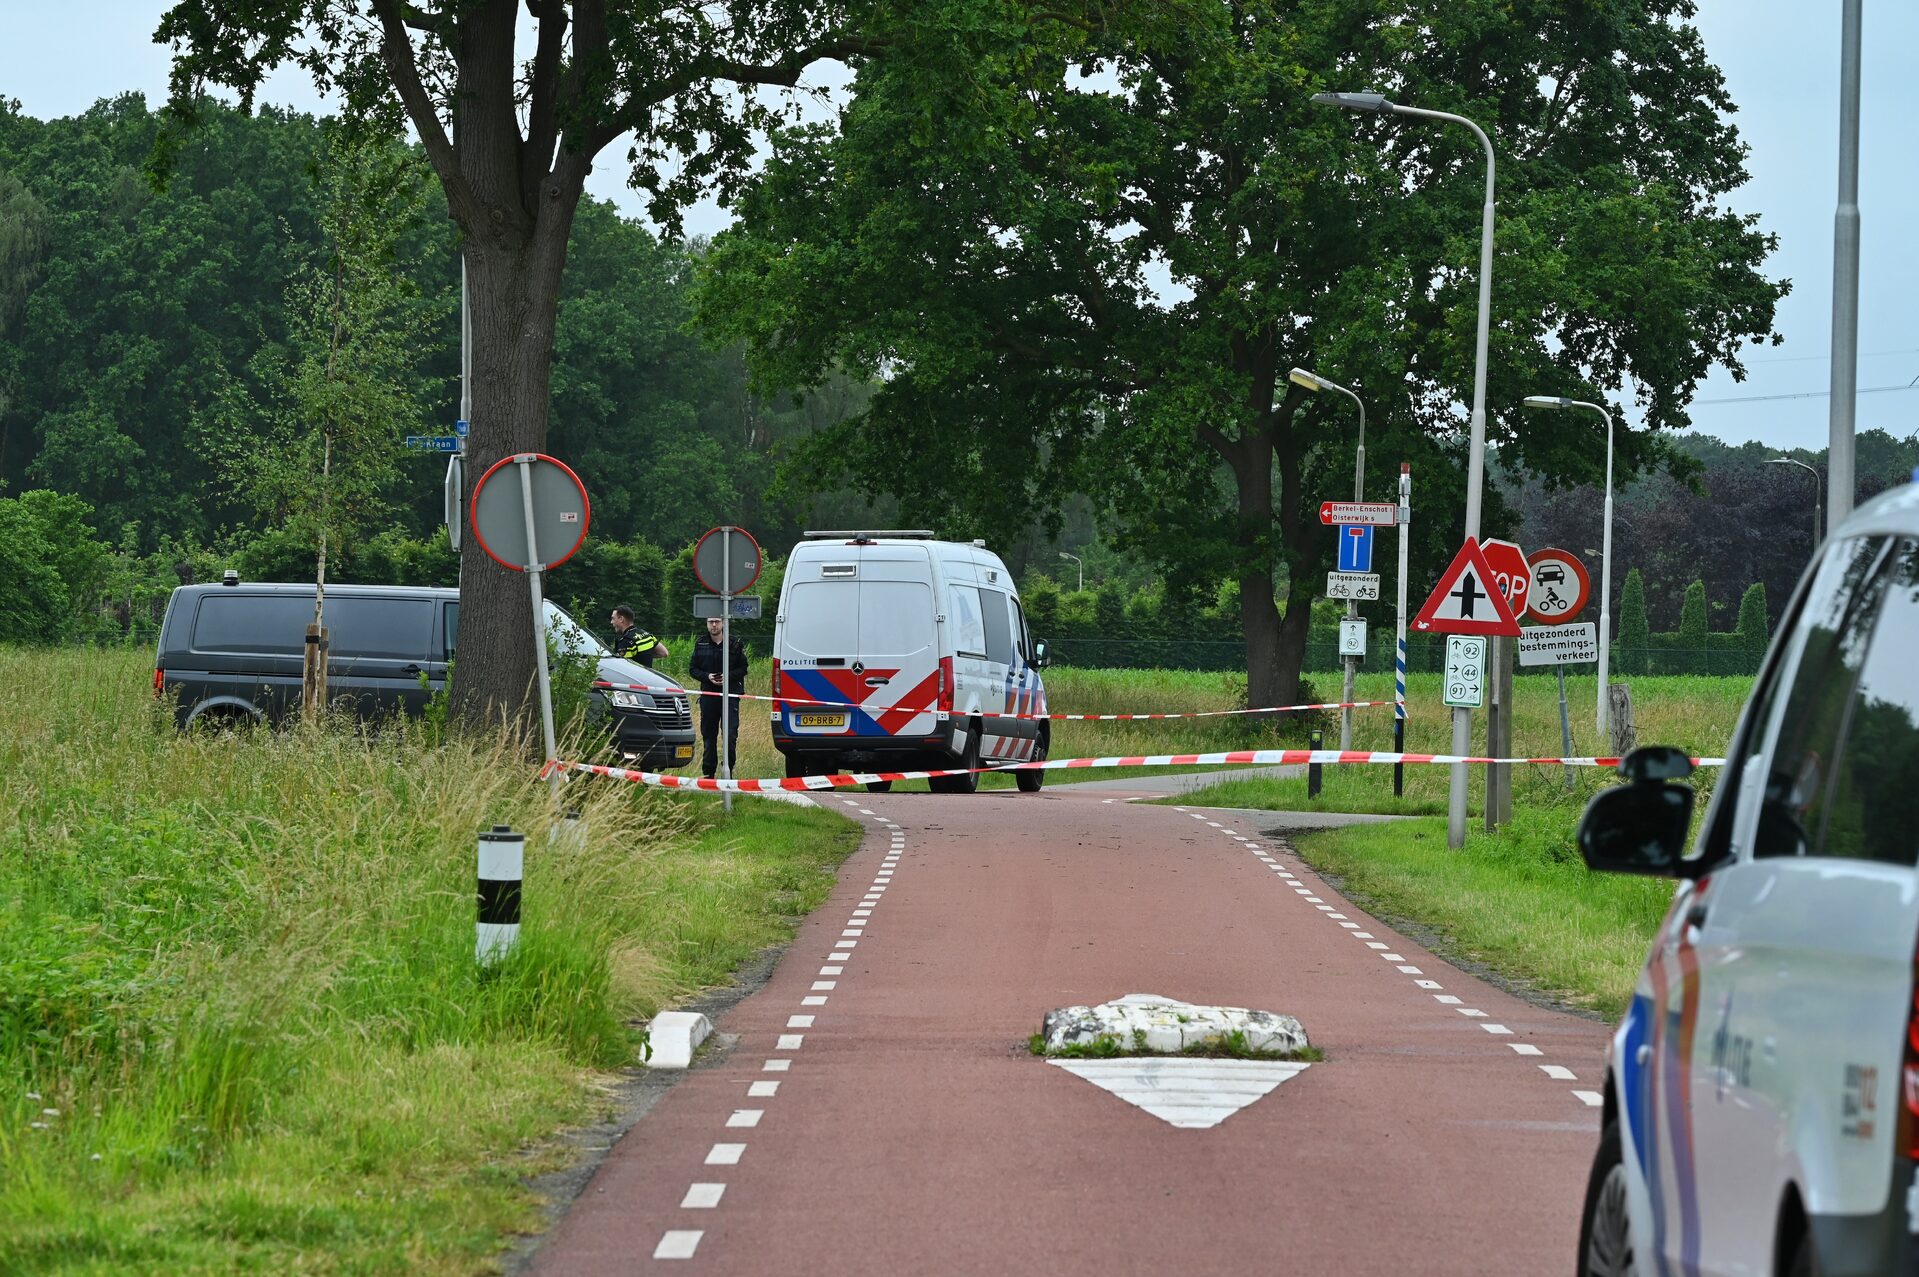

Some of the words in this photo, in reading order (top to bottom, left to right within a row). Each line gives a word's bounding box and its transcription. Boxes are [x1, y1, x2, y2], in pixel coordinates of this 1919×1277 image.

[1333, 505, 1388, 513] Berkel-Enschot
[1332, 514, 1369, 523] Oisterwijk
[1329, 574, 1379, 583] uitgezonderd
[1490, 570, 1527, 600] OP
[1520, 639, 1594, 652] bestemmings-
[1465, 646, 1478, 655] 92
[1556, 651, 1595, 661] verkeer
[1464, 669, 1476, 677] 44
[1452, 687, 1464, 695] 91
[802, 716, 841, 725] 09-BRB-7
